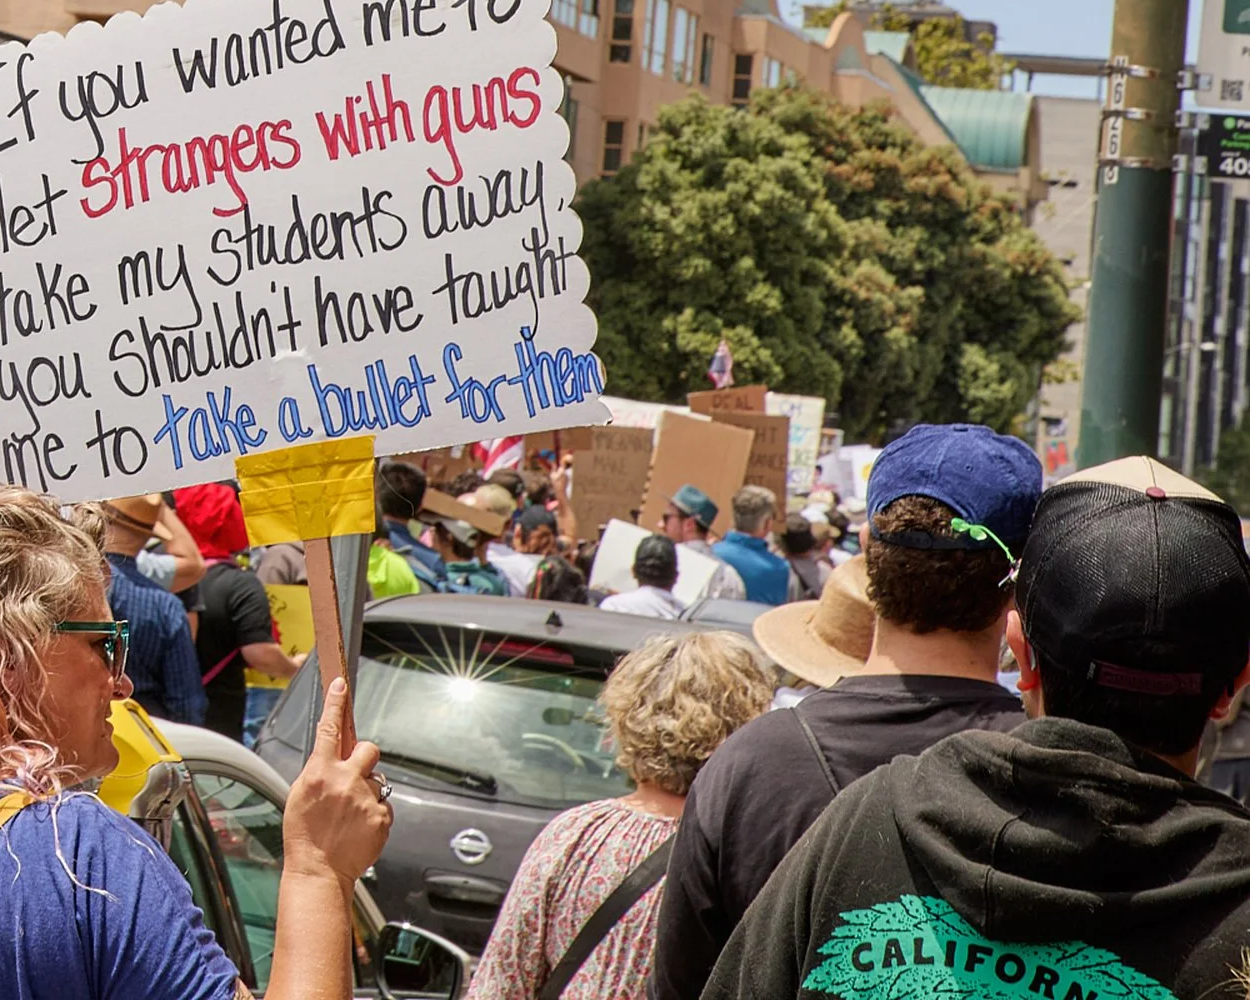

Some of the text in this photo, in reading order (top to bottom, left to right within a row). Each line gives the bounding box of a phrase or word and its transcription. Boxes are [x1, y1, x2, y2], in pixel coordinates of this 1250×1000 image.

[58, 60, 149, 163] you
[79, 118, 302, 218] strangers
[316, 73, 415, 161] with
[423, 67, 541, 187] guns
[119, 244, 202, 330] my
[207, 187, 408, 286] students
[314, 274, 423, 347] have
[432, 227, 577, 341] taught
[1, 326, 604, 494] me to take a bullet for them
